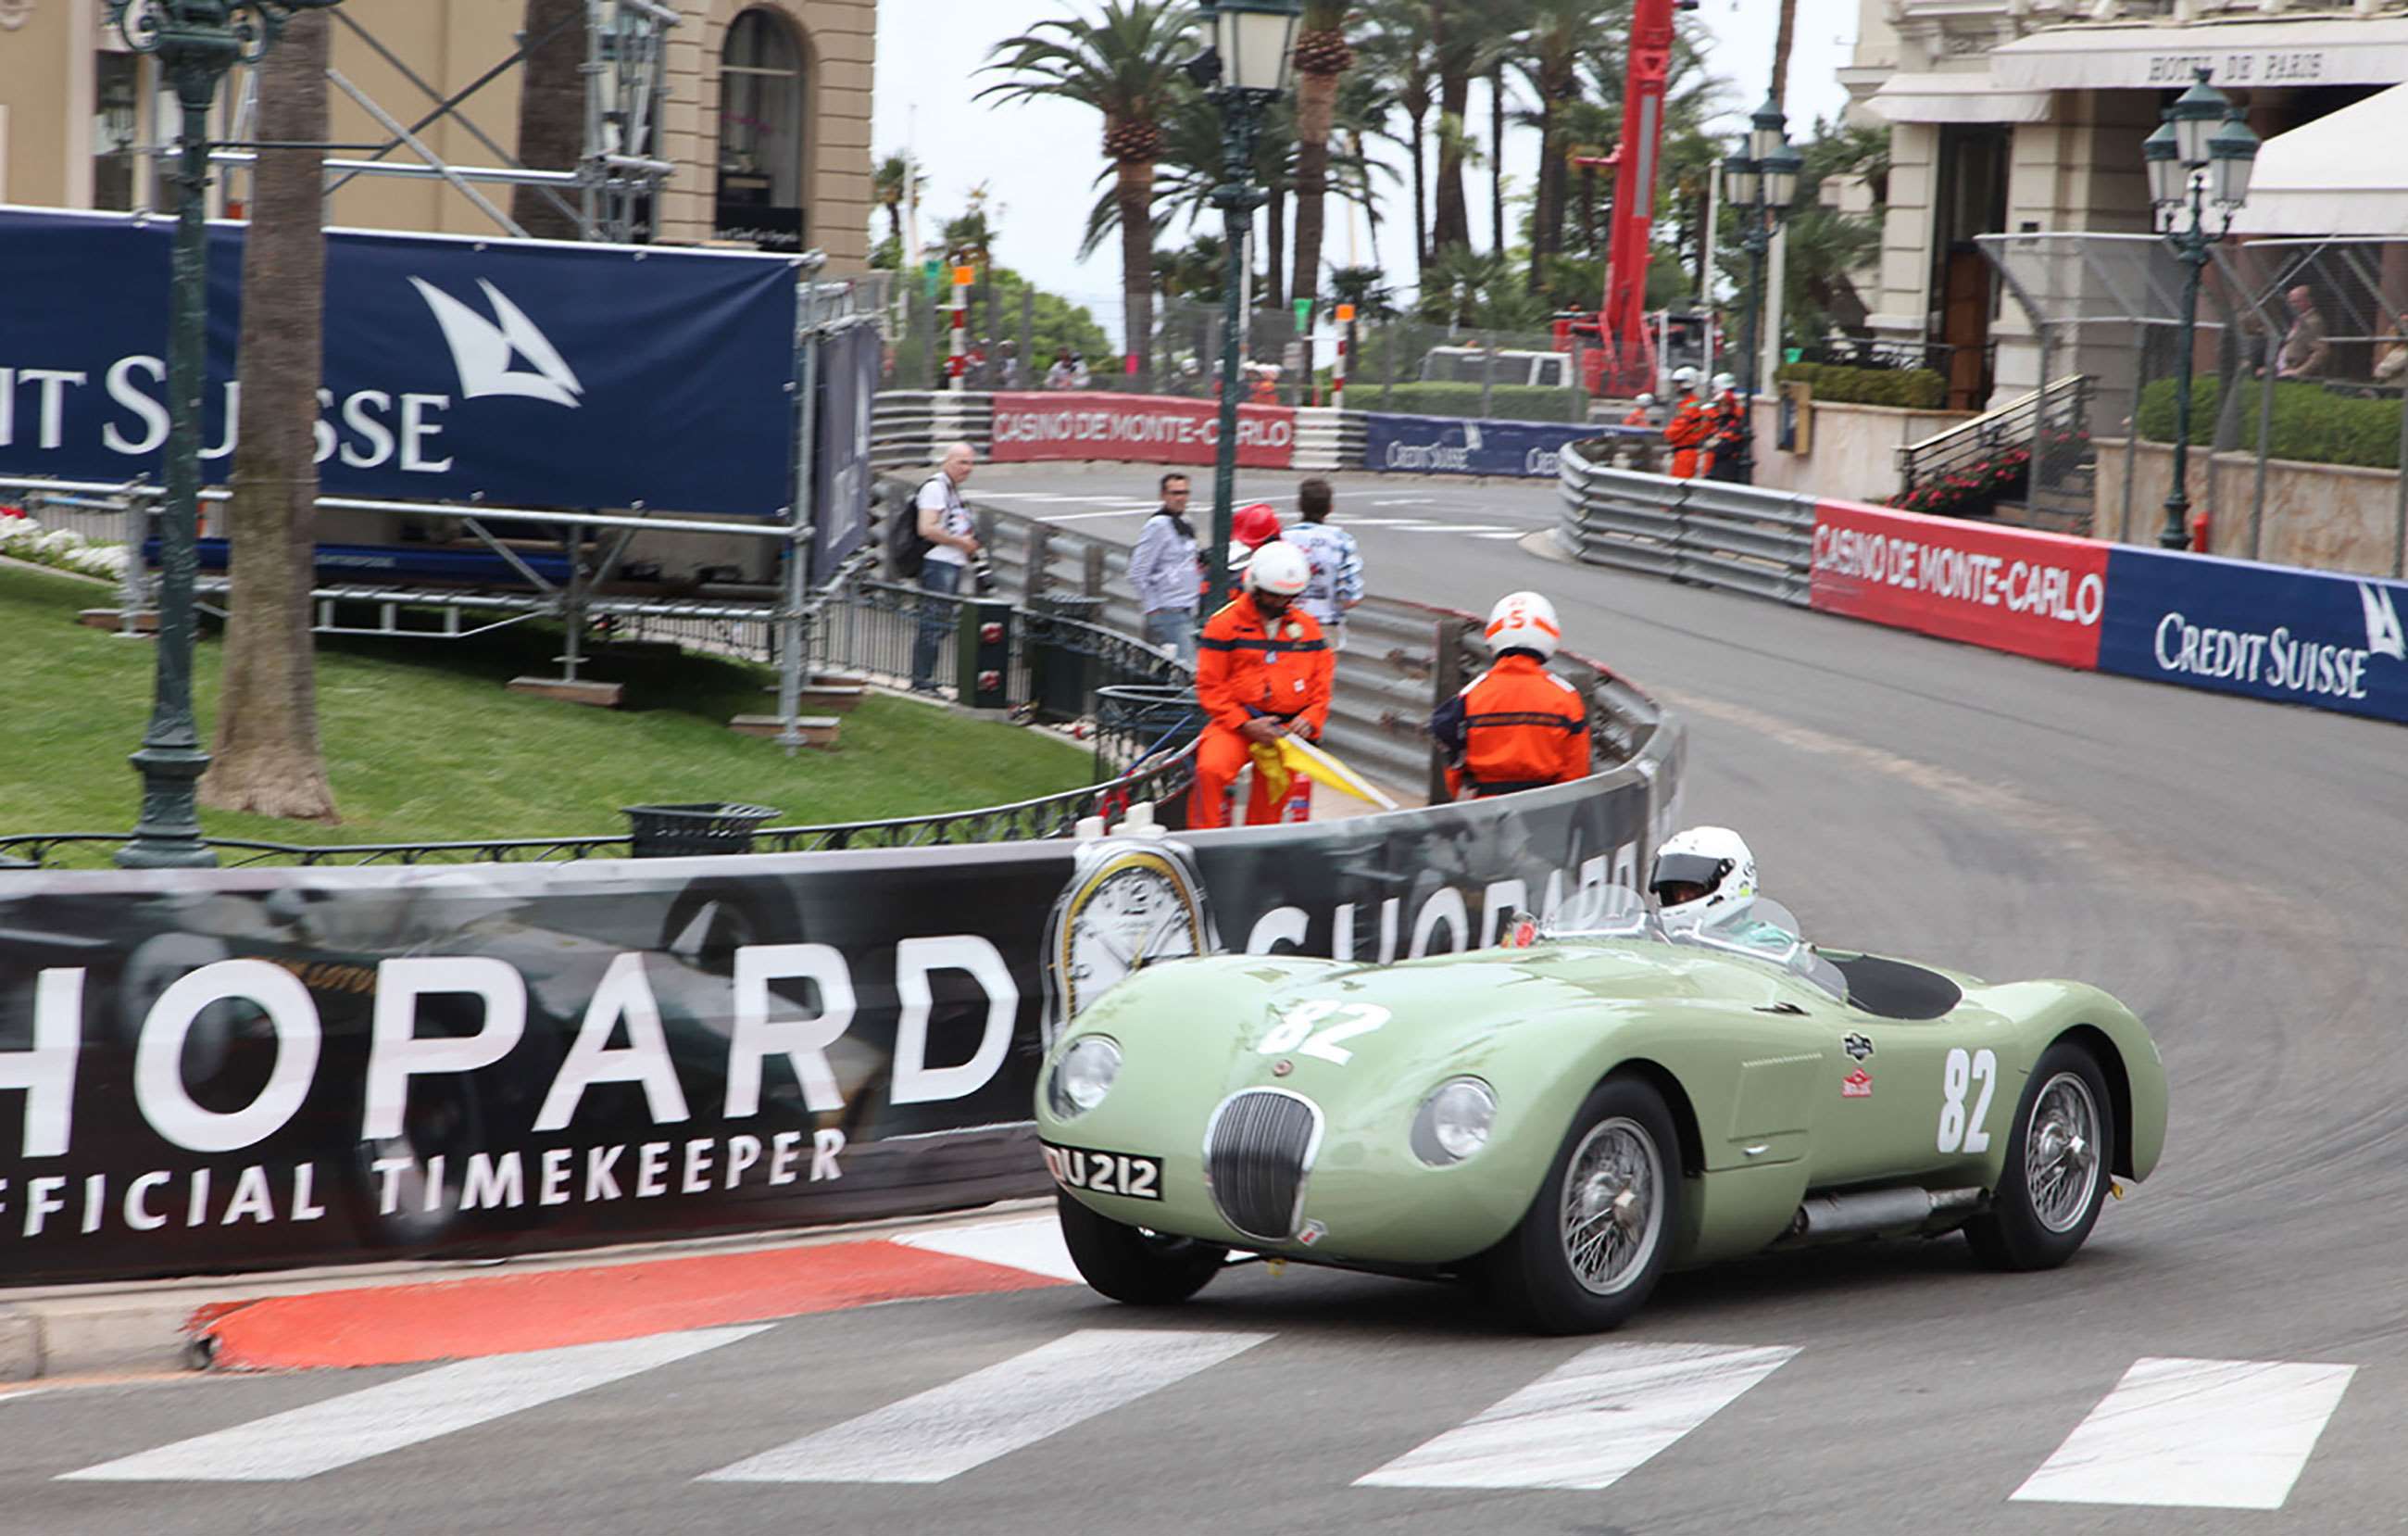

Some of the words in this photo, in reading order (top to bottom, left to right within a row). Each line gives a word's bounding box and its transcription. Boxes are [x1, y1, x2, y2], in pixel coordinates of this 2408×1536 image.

[2226, 55, 2253, 80] DE
[2264, 53, 2323, 79] PARIS
[994, 411, 1072, 442] CASINO
[1074, 413, 1108, 441] DE
[1110, 414, 1291, 447] MONTE-CRLO
[1812, 524, 1886, 583] CASINO
[1886, 538, 1919, 589] DE
[1917, 544, 2103, 625] MONTE-CARLO
[2155, 611, 2268, 683] CREDIT
[2265, 626, 2369, 699] SUISSE
[1256, 999, 1392, 1066] 82
[1937, 1048, 1997, 1153] 82
[372, 1127, 848, 1215] TIMEKEEPER
